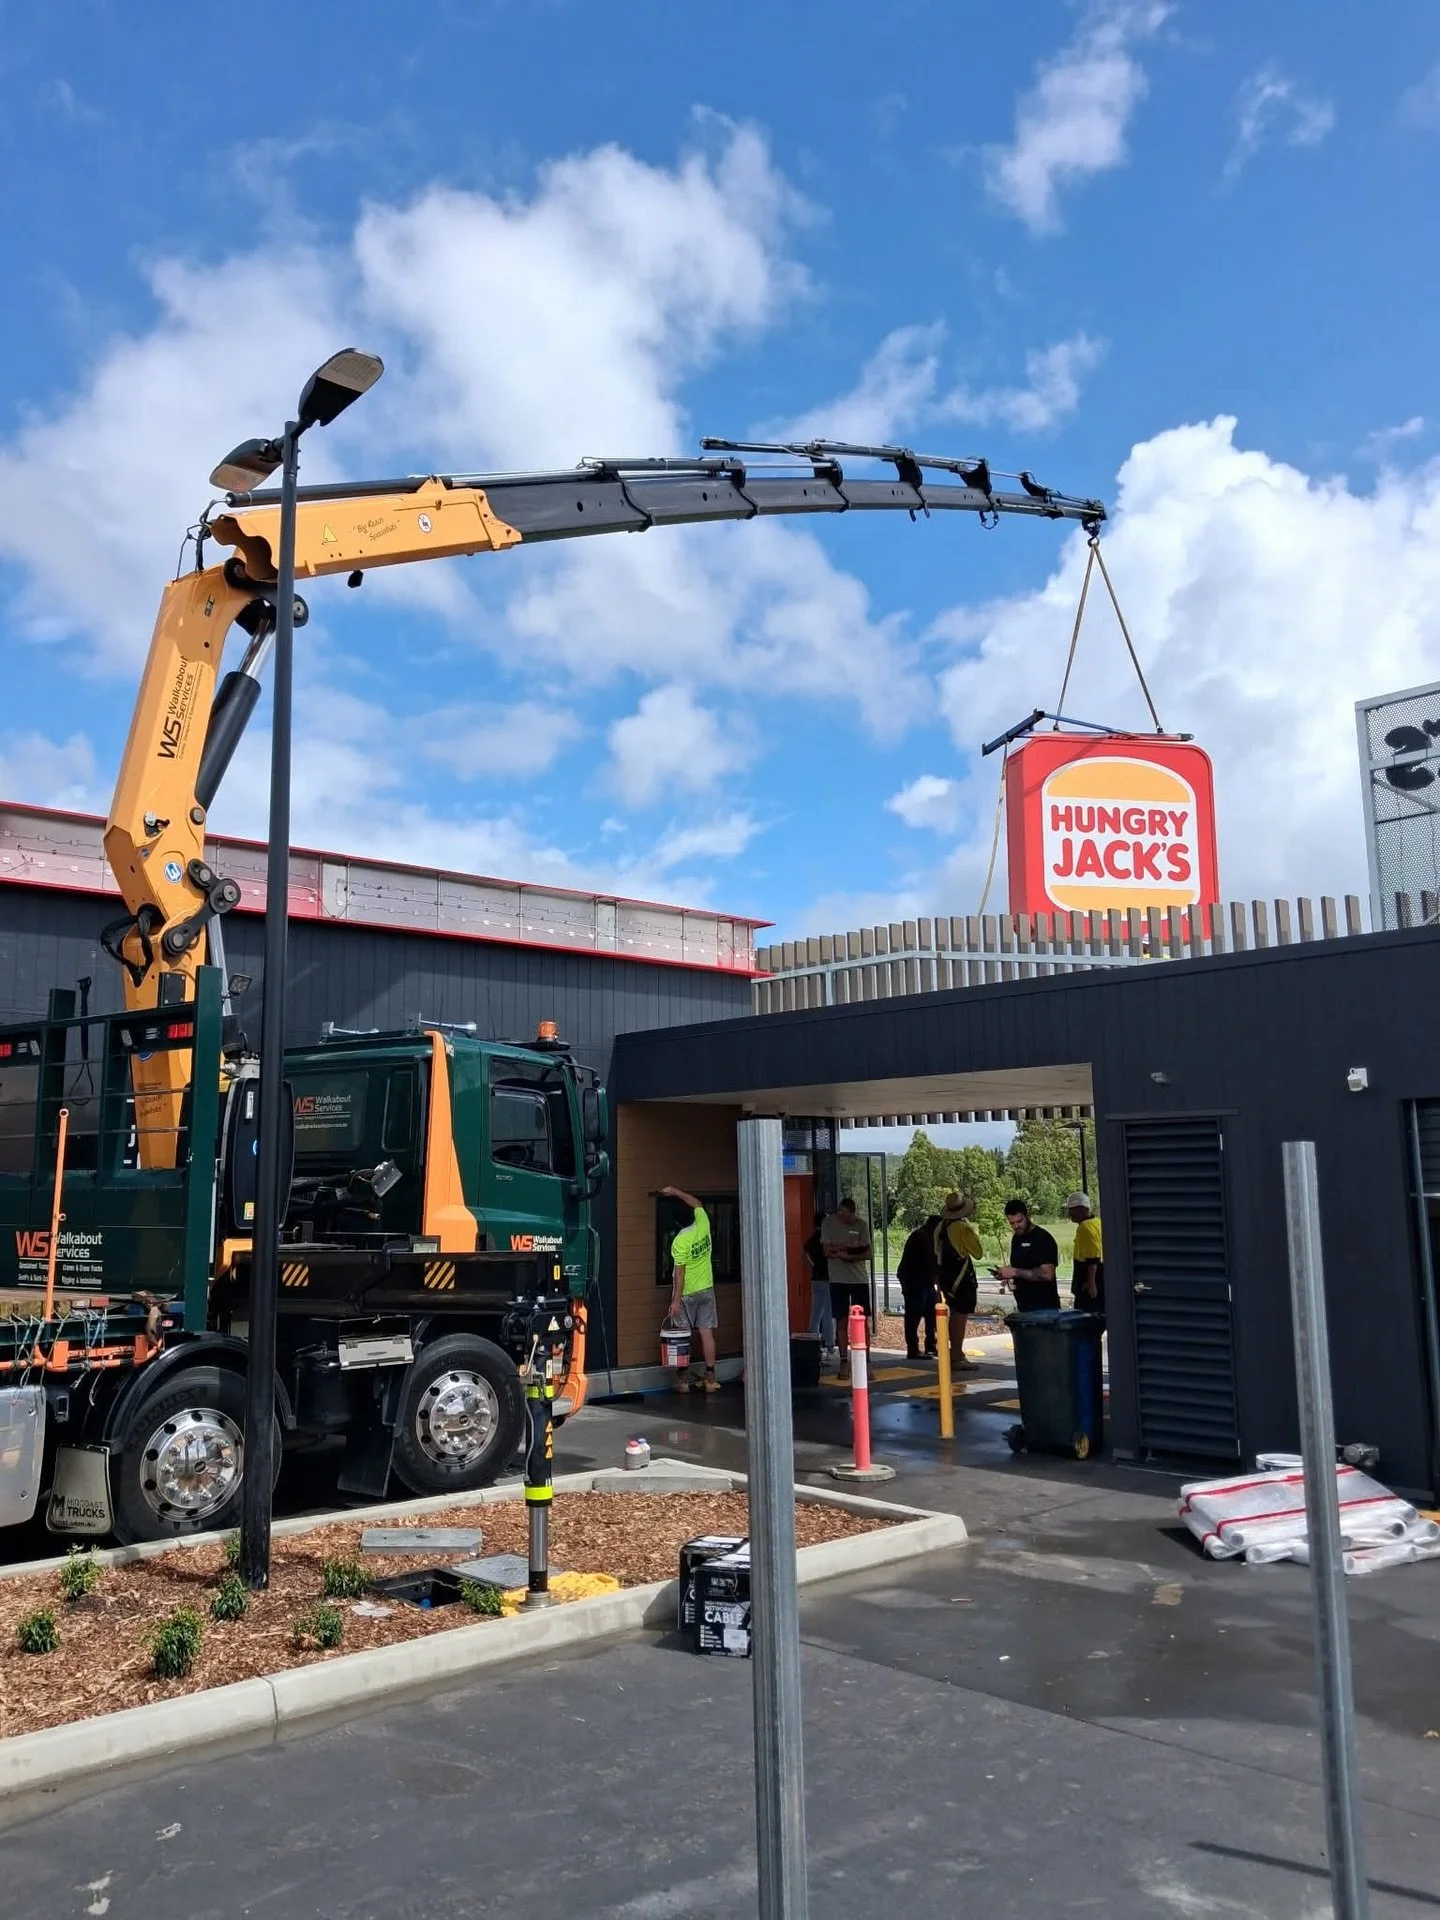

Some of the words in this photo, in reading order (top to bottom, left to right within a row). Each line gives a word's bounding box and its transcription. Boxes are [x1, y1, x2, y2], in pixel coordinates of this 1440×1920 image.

[167, 655, 188, 715] Walkabout
[176, 673, 194, 720] Services
[157, 715, 182, 759] WS
[1051, 805, 1188, 837] HUNGRY
[1053, 838, 1191, 881] JACK'S
[314, 1104, 343, 1112] Services
[315, 1095, 352, 1104] Walkabout
[16, 1231, 50, 1257] WS
[56, 1245, 90, 1258] ervices
[511, 1235, 533, 1252] WS
[68, 1506, 106, 1518] TRUCKS
[705, 1611, 743, 1625] CABLE
